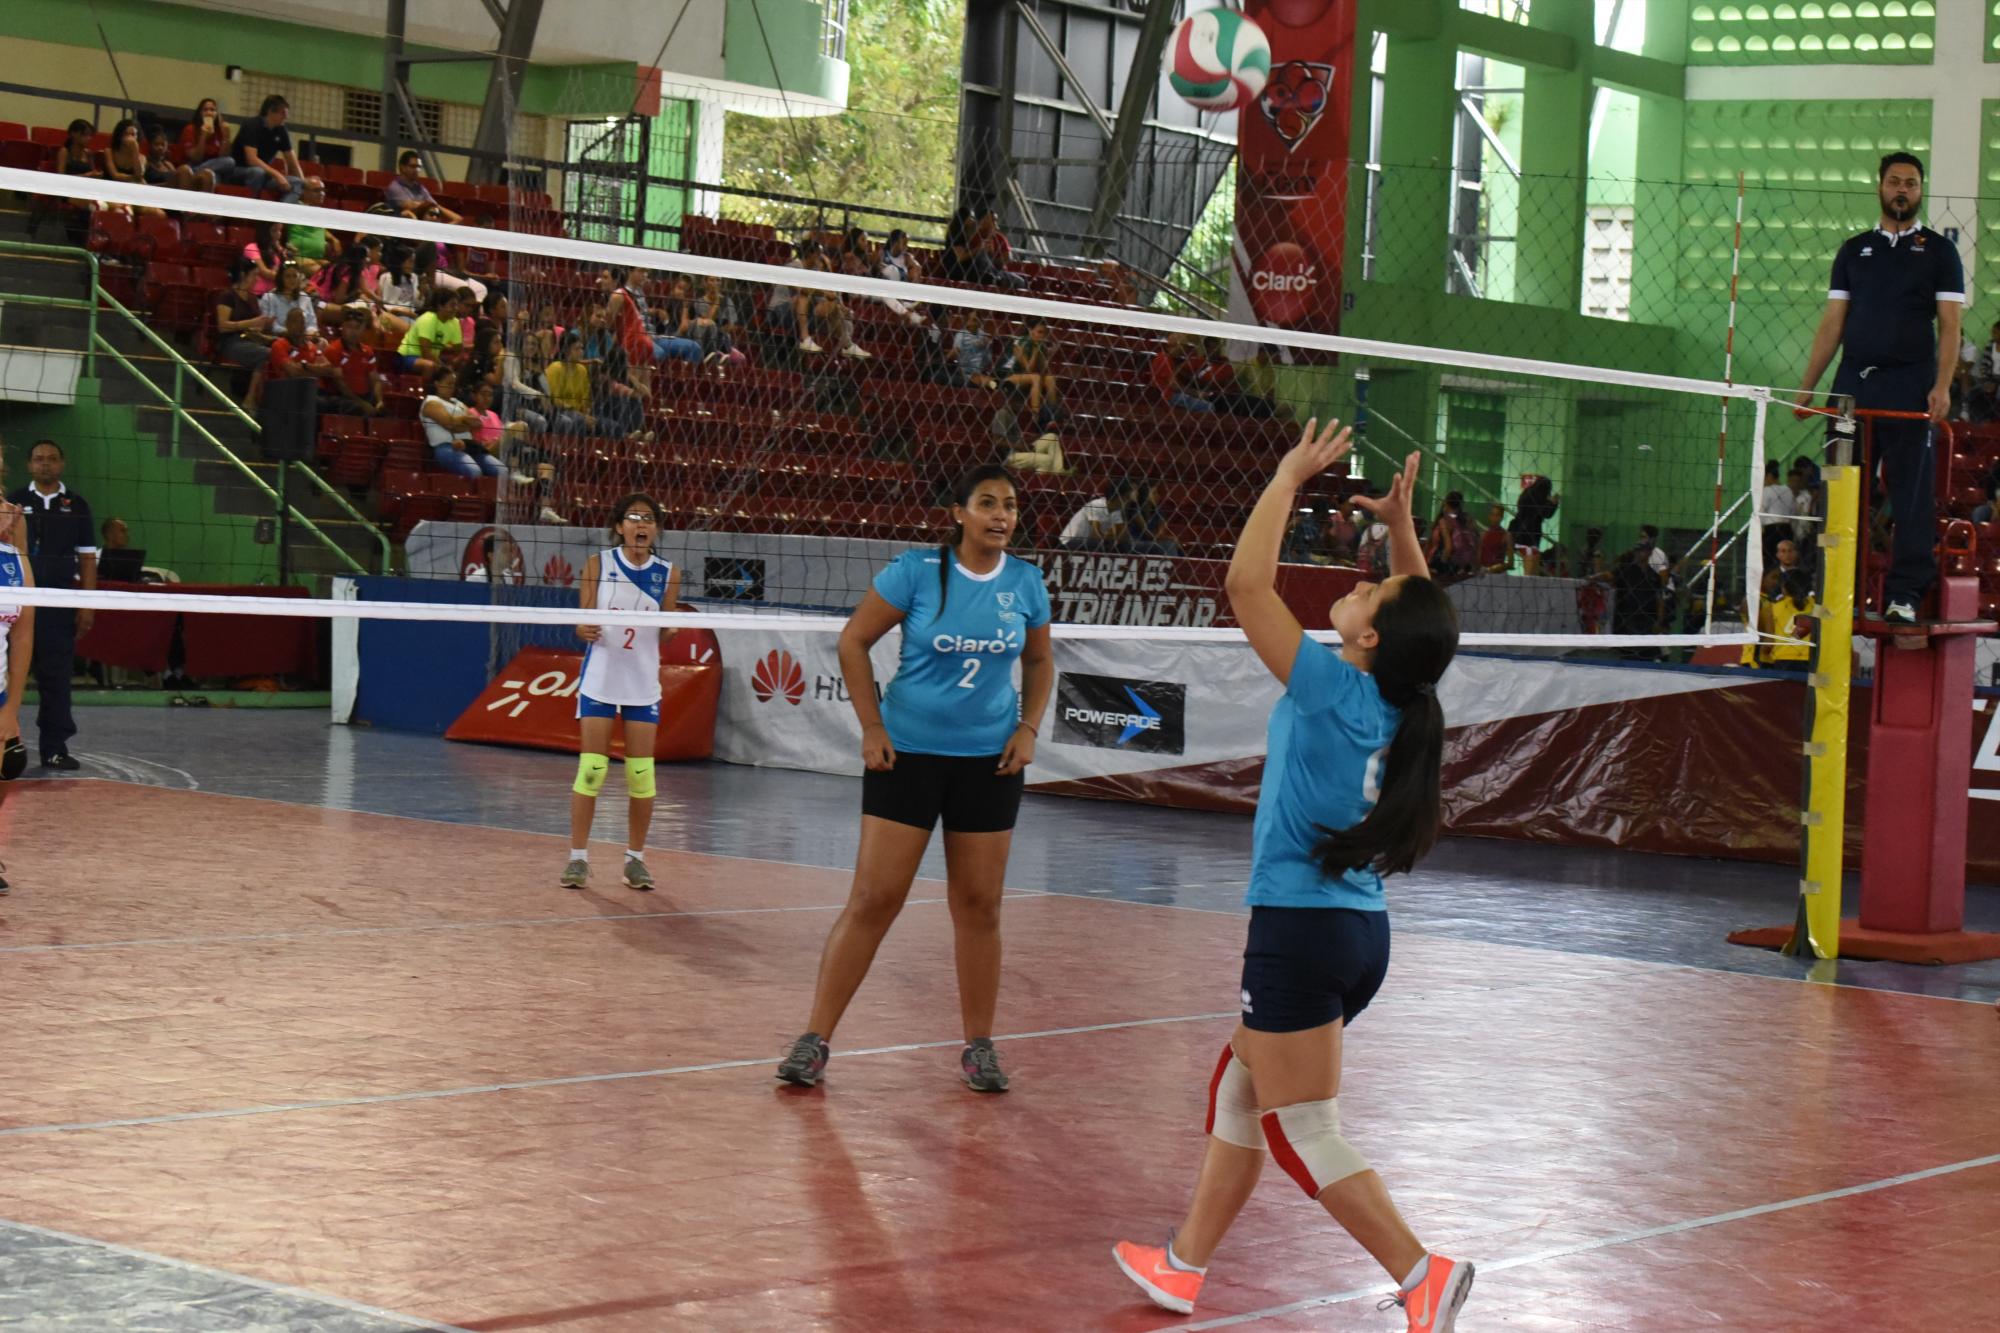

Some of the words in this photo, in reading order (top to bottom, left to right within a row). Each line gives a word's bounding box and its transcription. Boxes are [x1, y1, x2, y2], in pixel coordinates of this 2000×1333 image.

[1252, 270, 1308, 291] Claro
[1069, 555, 1137, 590] TAREA
[1140, 559, 1173, 591] ES
[623, 628, 635, 649] 2
[933, 633, 1006, 653] Claro
[957, 658, 981, 688] 2
[1065, 707, 1161, 730] POWERADE
